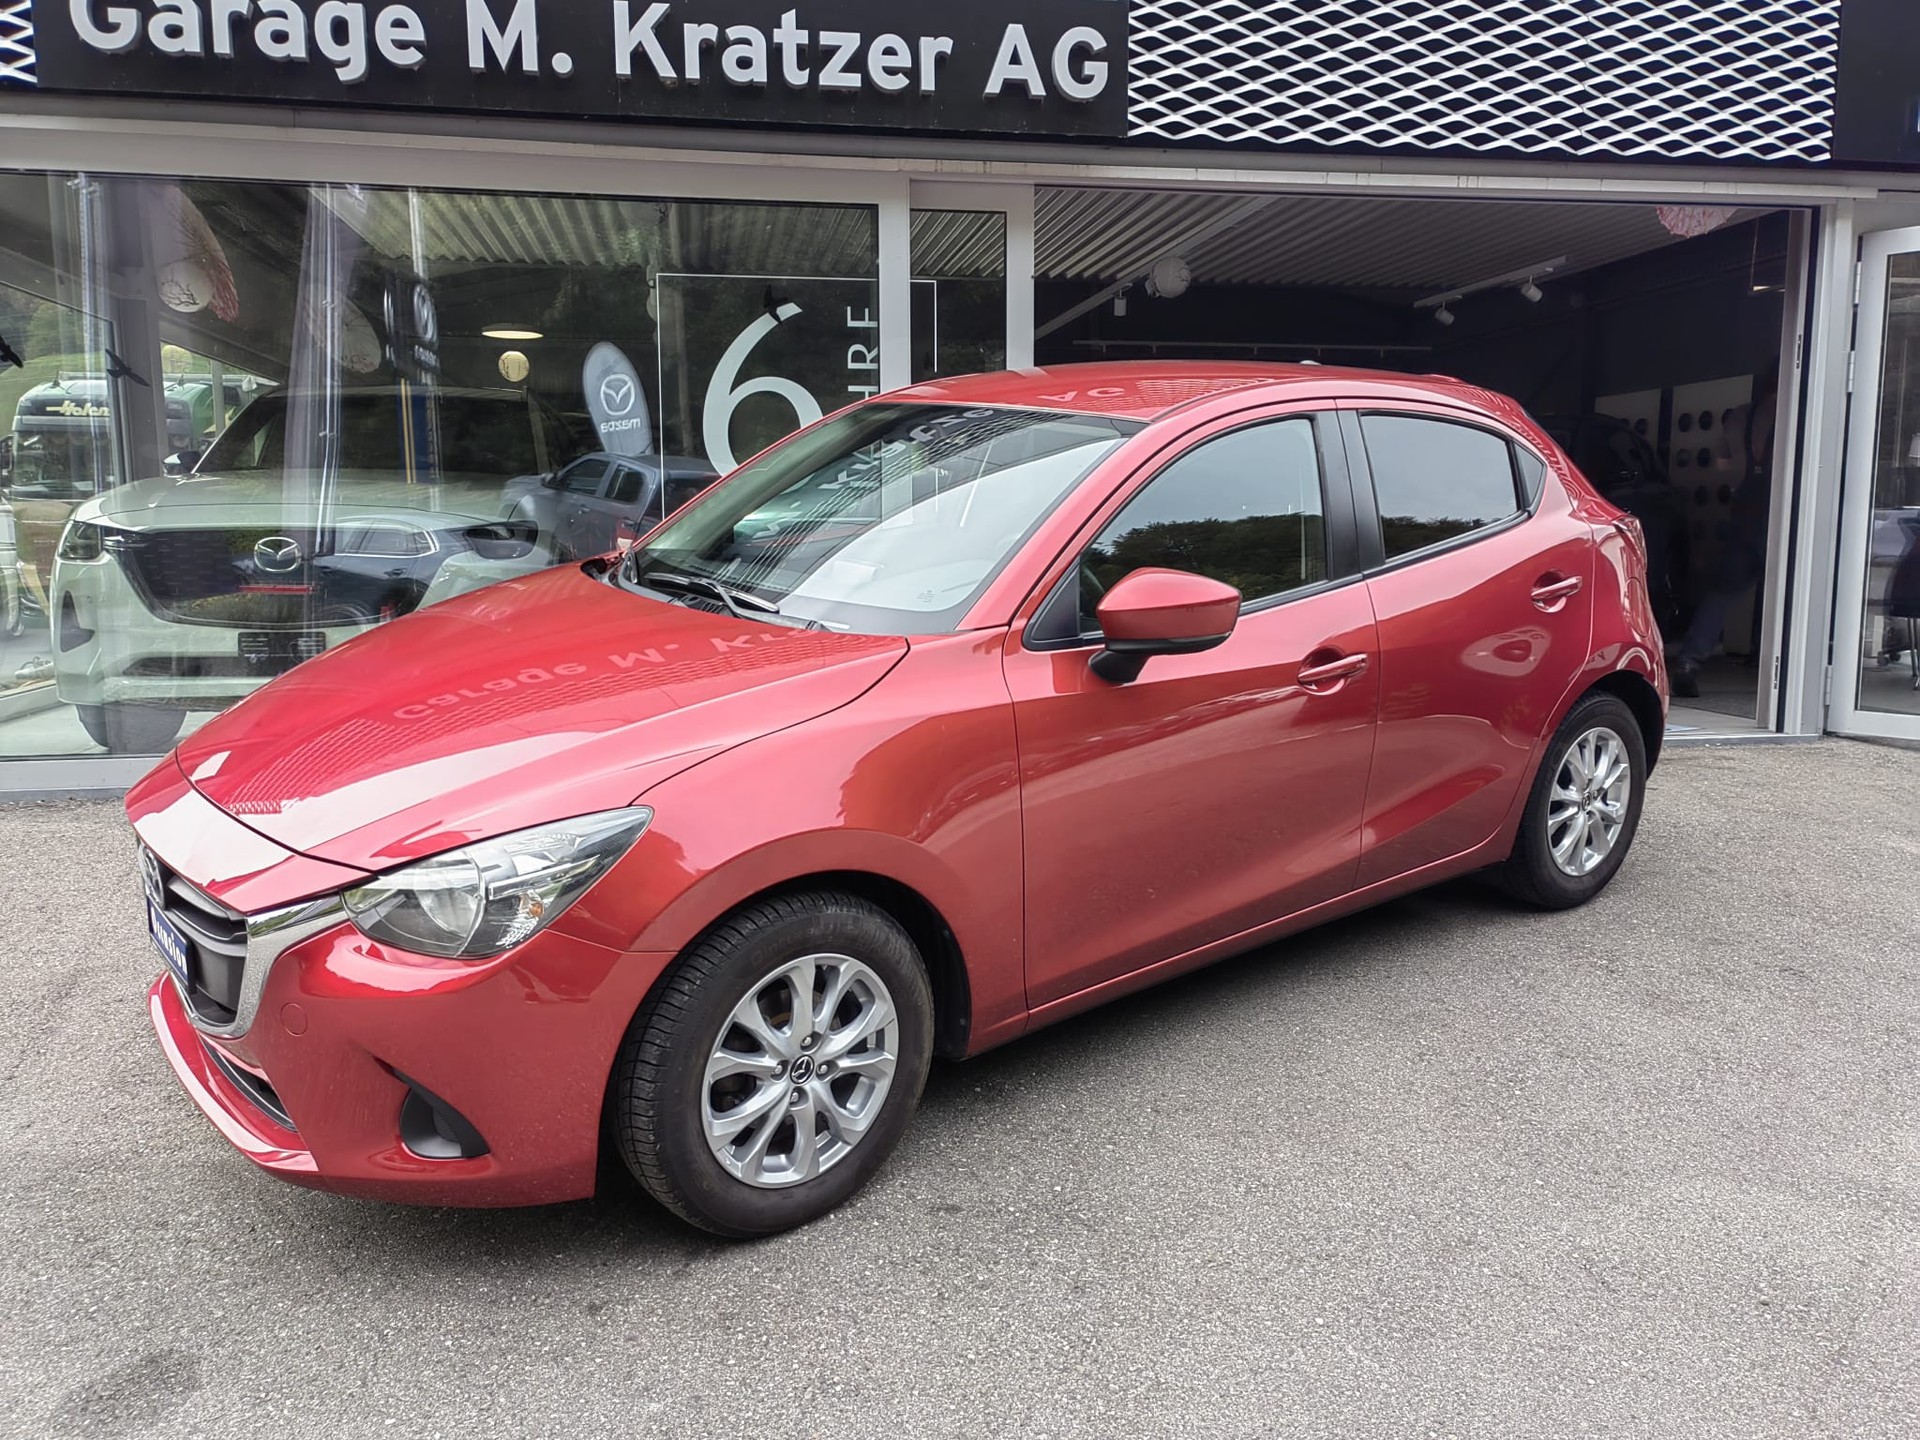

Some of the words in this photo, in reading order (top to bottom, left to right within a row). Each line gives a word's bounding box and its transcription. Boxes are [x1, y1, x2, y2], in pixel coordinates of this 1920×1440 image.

[69, 0, 426, 82] Garage
[466, 0, 573, 75] M.
[614, 0, 953, 91] Kratzer
[984, 25, 1109, 99] AG
[702, 302, 824, 478] 6
